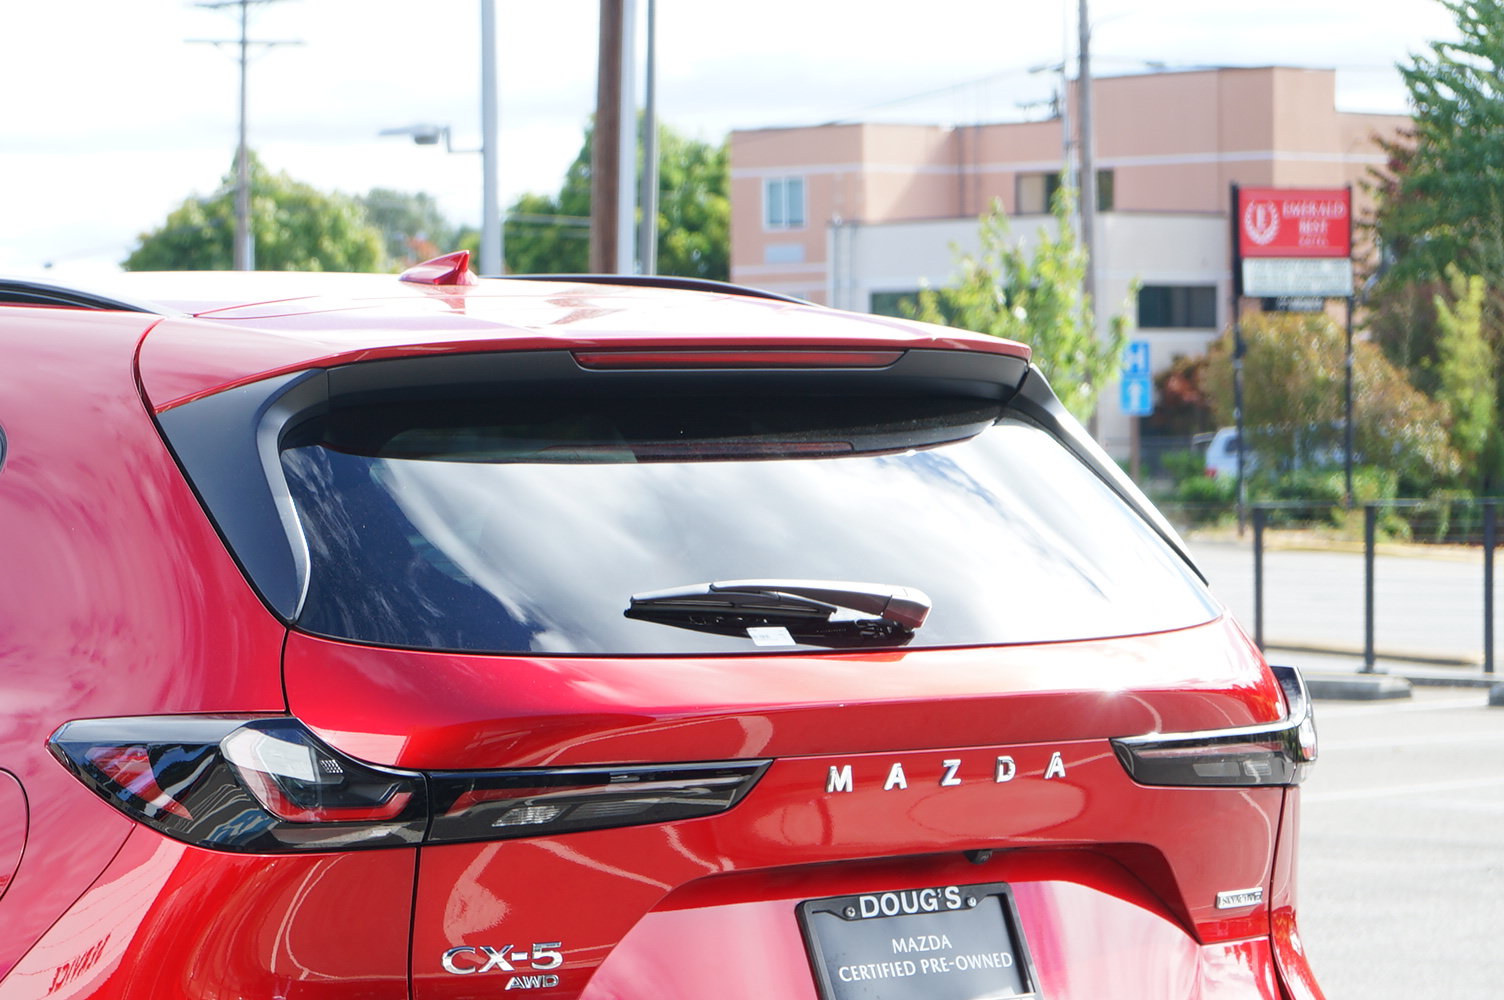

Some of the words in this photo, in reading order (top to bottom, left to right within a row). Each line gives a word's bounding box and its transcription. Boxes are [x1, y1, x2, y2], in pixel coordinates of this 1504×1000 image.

[826, 751, 1066, 793] MAZDA
[859, 886, 961, 918] DOUG'S
[442, 941, 563, 975] CX-5
[892, 934, 952, 954] MAZDA
[504, 974, 559, 991] AWD
[838, 961, 916, 982] CERTIFIED
[921, 952, 1013, 975] PRE-OWNED
